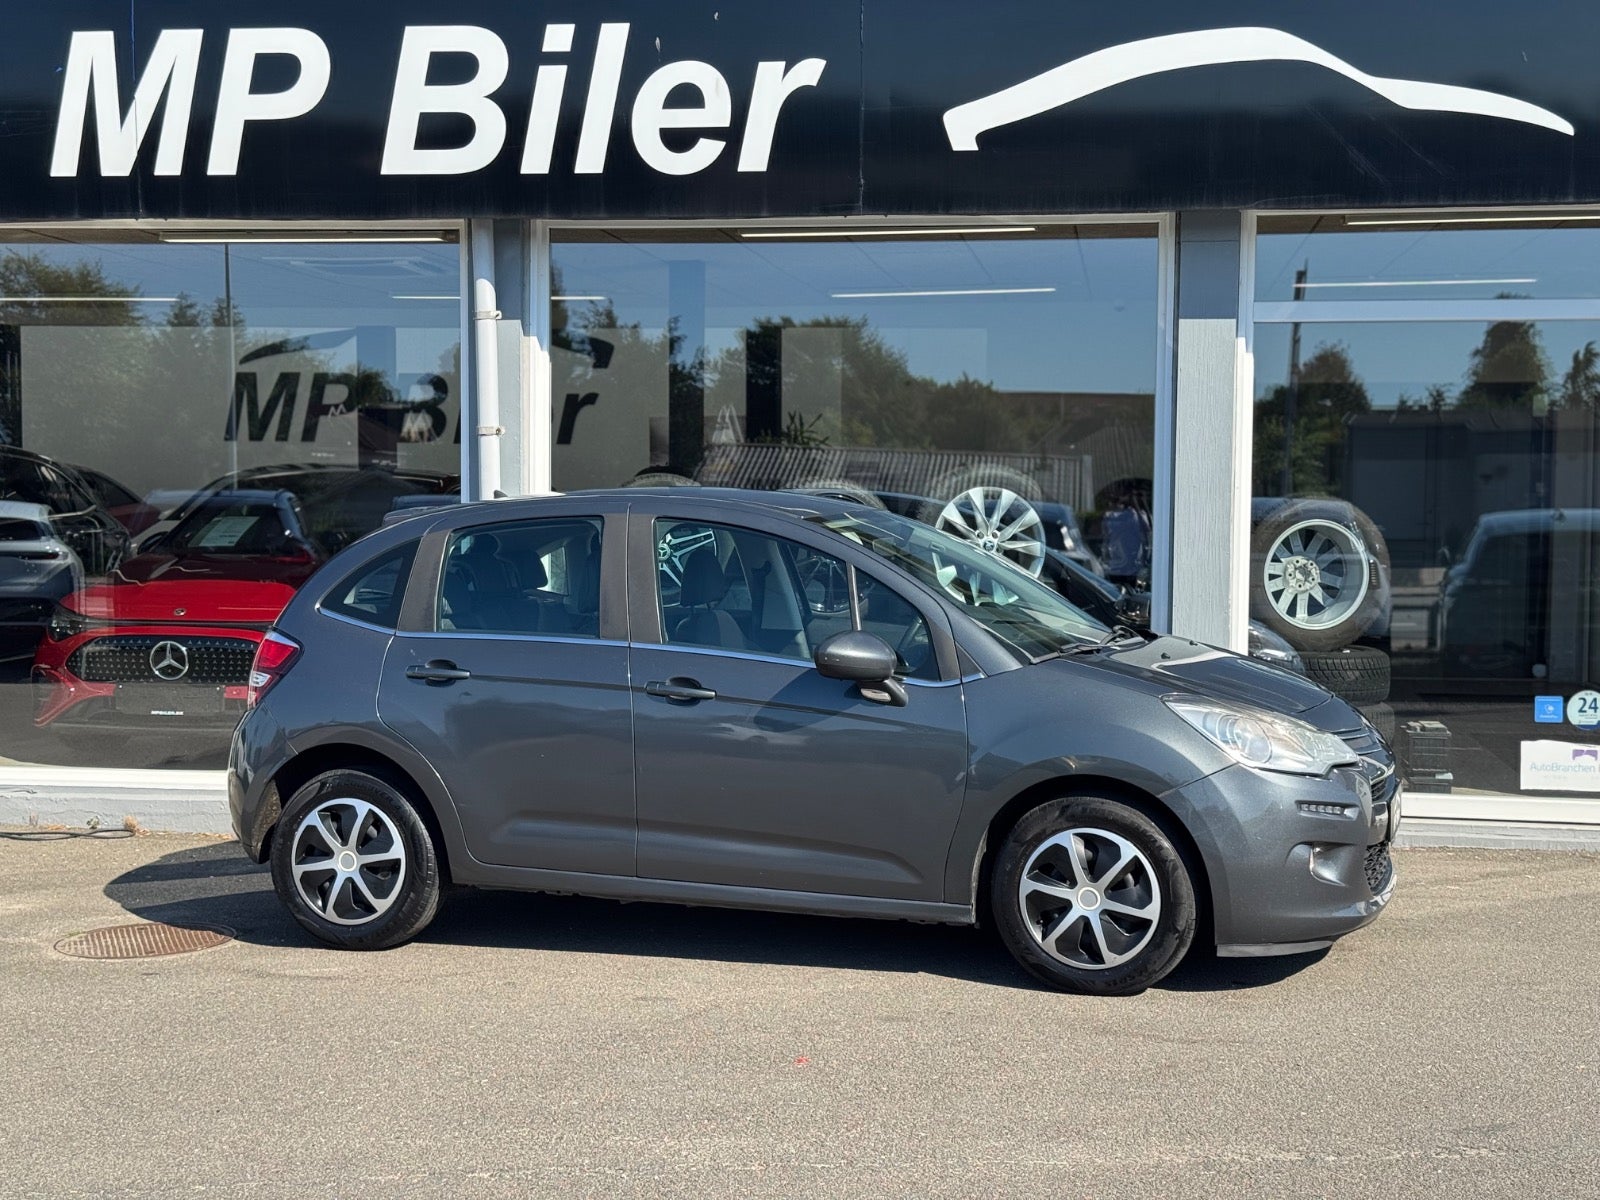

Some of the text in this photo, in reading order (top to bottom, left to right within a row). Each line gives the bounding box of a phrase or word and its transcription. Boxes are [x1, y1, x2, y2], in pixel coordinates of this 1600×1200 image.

[50, 22, 827, 178] MP Biler
[224, 372, 360, 442] MP
[1577, 697, 1599, 713] 24
[1529, 762, 1596, 773] AutoBranchen
